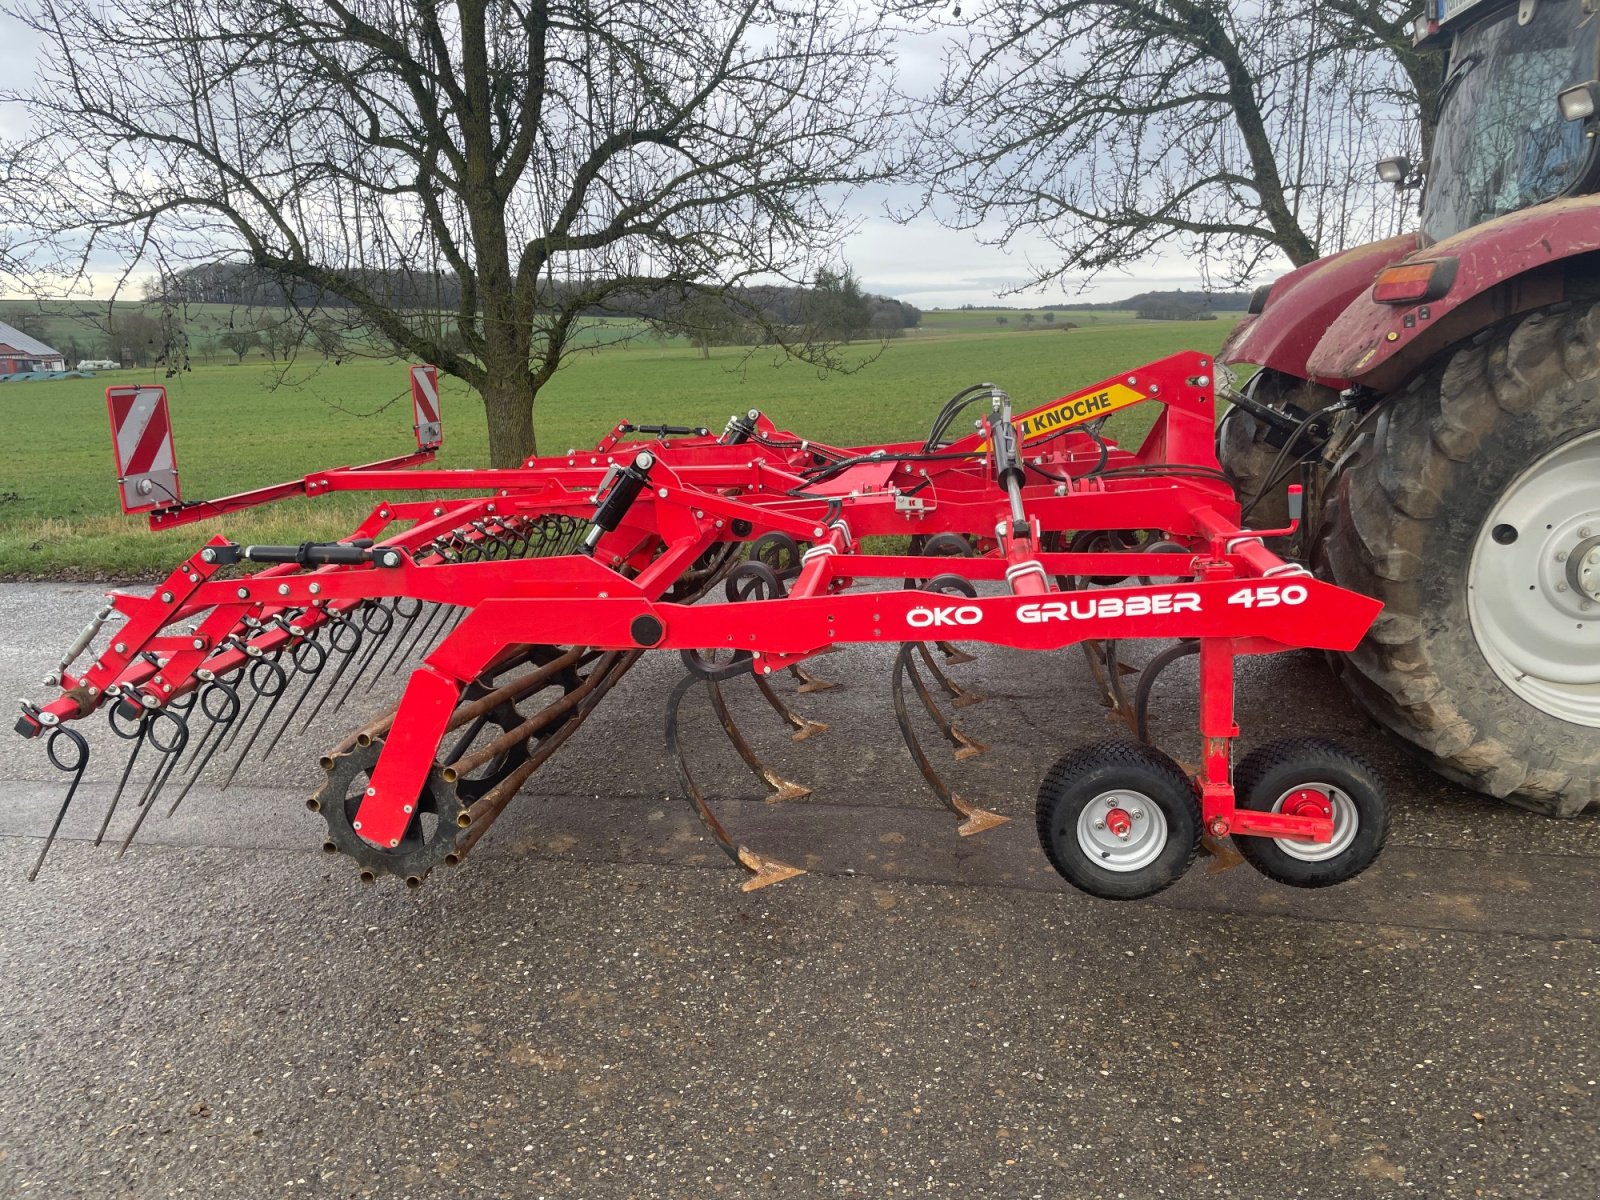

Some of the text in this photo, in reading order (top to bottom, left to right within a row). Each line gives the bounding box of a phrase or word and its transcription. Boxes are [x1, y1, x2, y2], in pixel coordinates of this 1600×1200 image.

[1034, 392, 1112, 431] KNOCHE
[906, 586, 1308, 628] ÖKO GRUBBER 450
